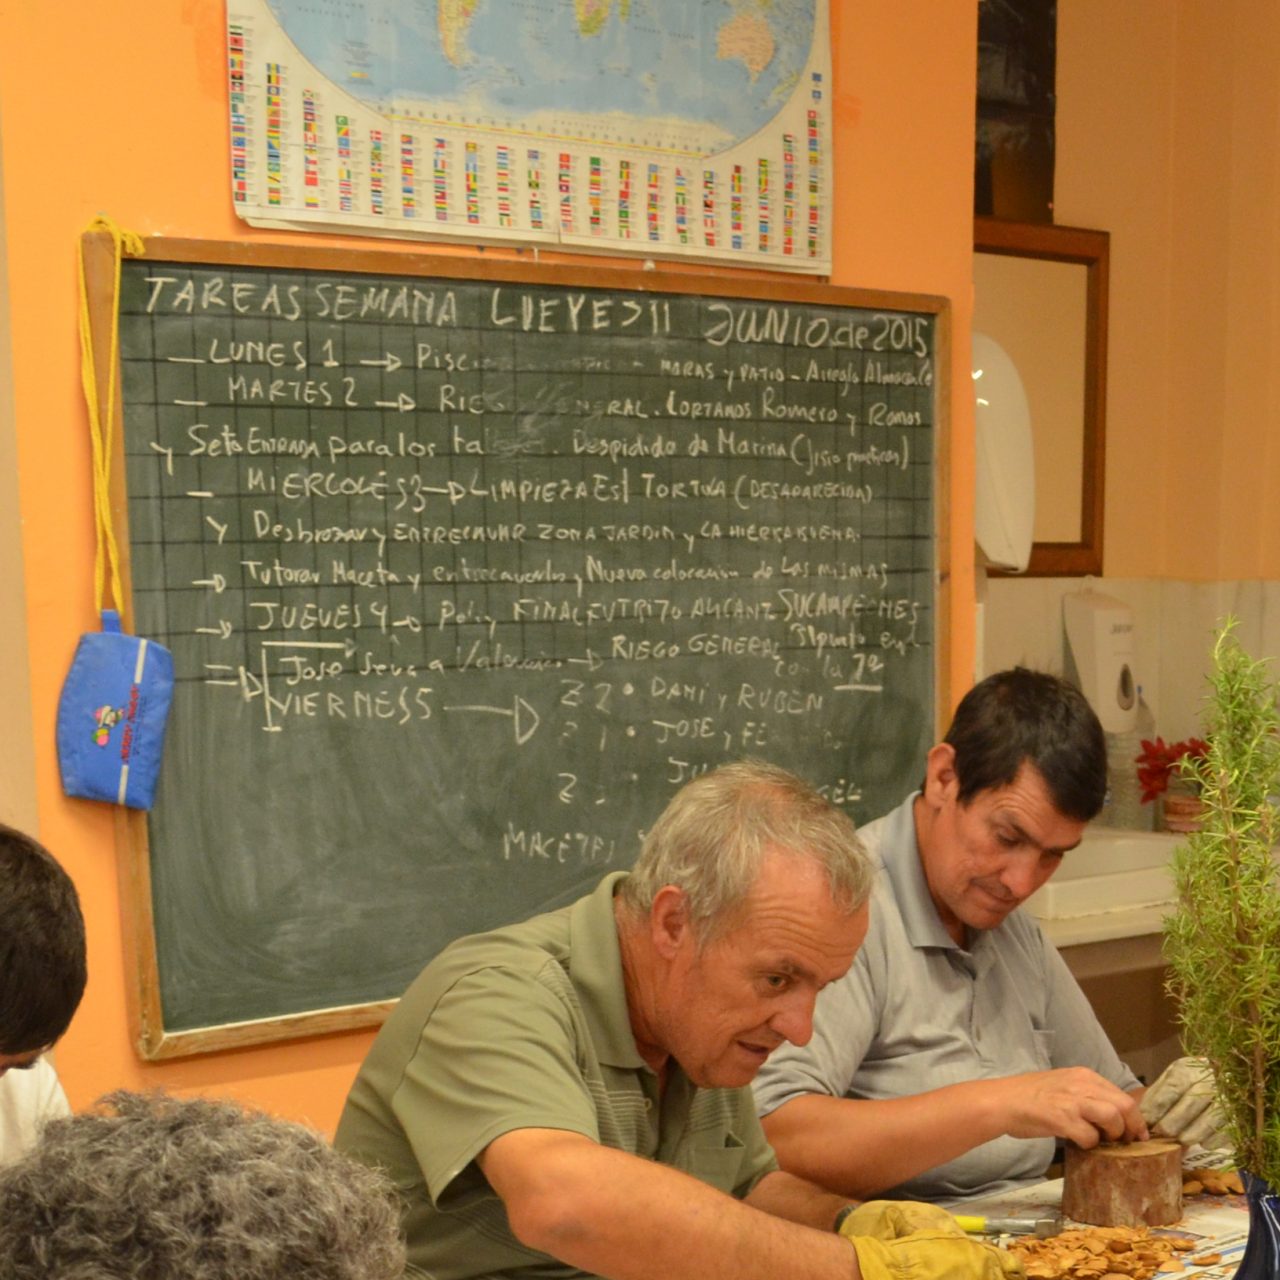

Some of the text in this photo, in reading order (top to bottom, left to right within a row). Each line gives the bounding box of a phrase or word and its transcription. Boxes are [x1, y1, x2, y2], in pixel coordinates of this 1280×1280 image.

[144, 277, 299, 320] TAREAS
[315, 283, 457, 327] SEMANA
[706, 303, 829, 347] JUNIO
[872, 314, 928, 357] 2015
[209, 338, 306, 368] LUNES
[228, 376, 329, 404] MARTES
[342, 377, 359, 407] 2
[250, 602, 361, 631] JUEVES
